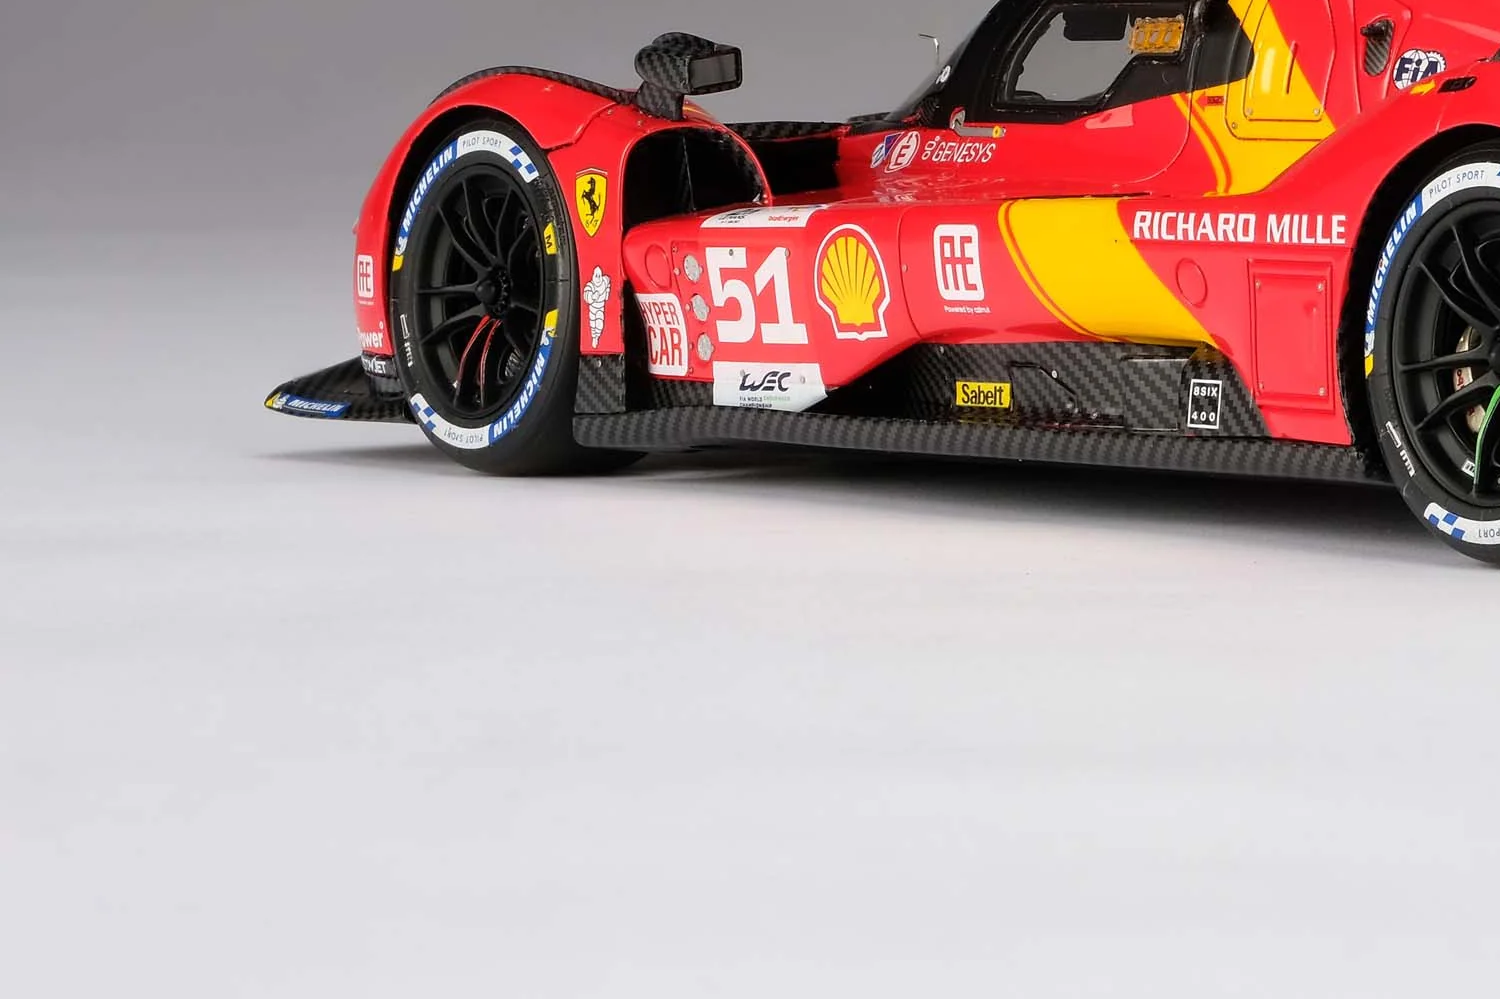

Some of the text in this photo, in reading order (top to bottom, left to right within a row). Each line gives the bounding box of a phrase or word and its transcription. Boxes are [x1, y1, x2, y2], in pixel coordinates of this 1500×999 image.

[461, 136, 502, 148] PILOT SPORT
[932, 142, 996, 162] GENESYS
[402, 146, 453, 233] MICHELIN
[1429, 169, 1485, 198] PILOT SPORT
[1133, 211, 1347, 245] RICHARD MILLE
[1367, 201, 1417, 326] MICHELIN
[705, 247, 808, 344] 51
[640, 302, 680, 326] HYPER
[648, 326, 682, 366] CAR
[493, 352, 545, 438] MICHELIN
[739, 371, 792, 392] WEC
[961, 384, 1004, 406] Sabelt
